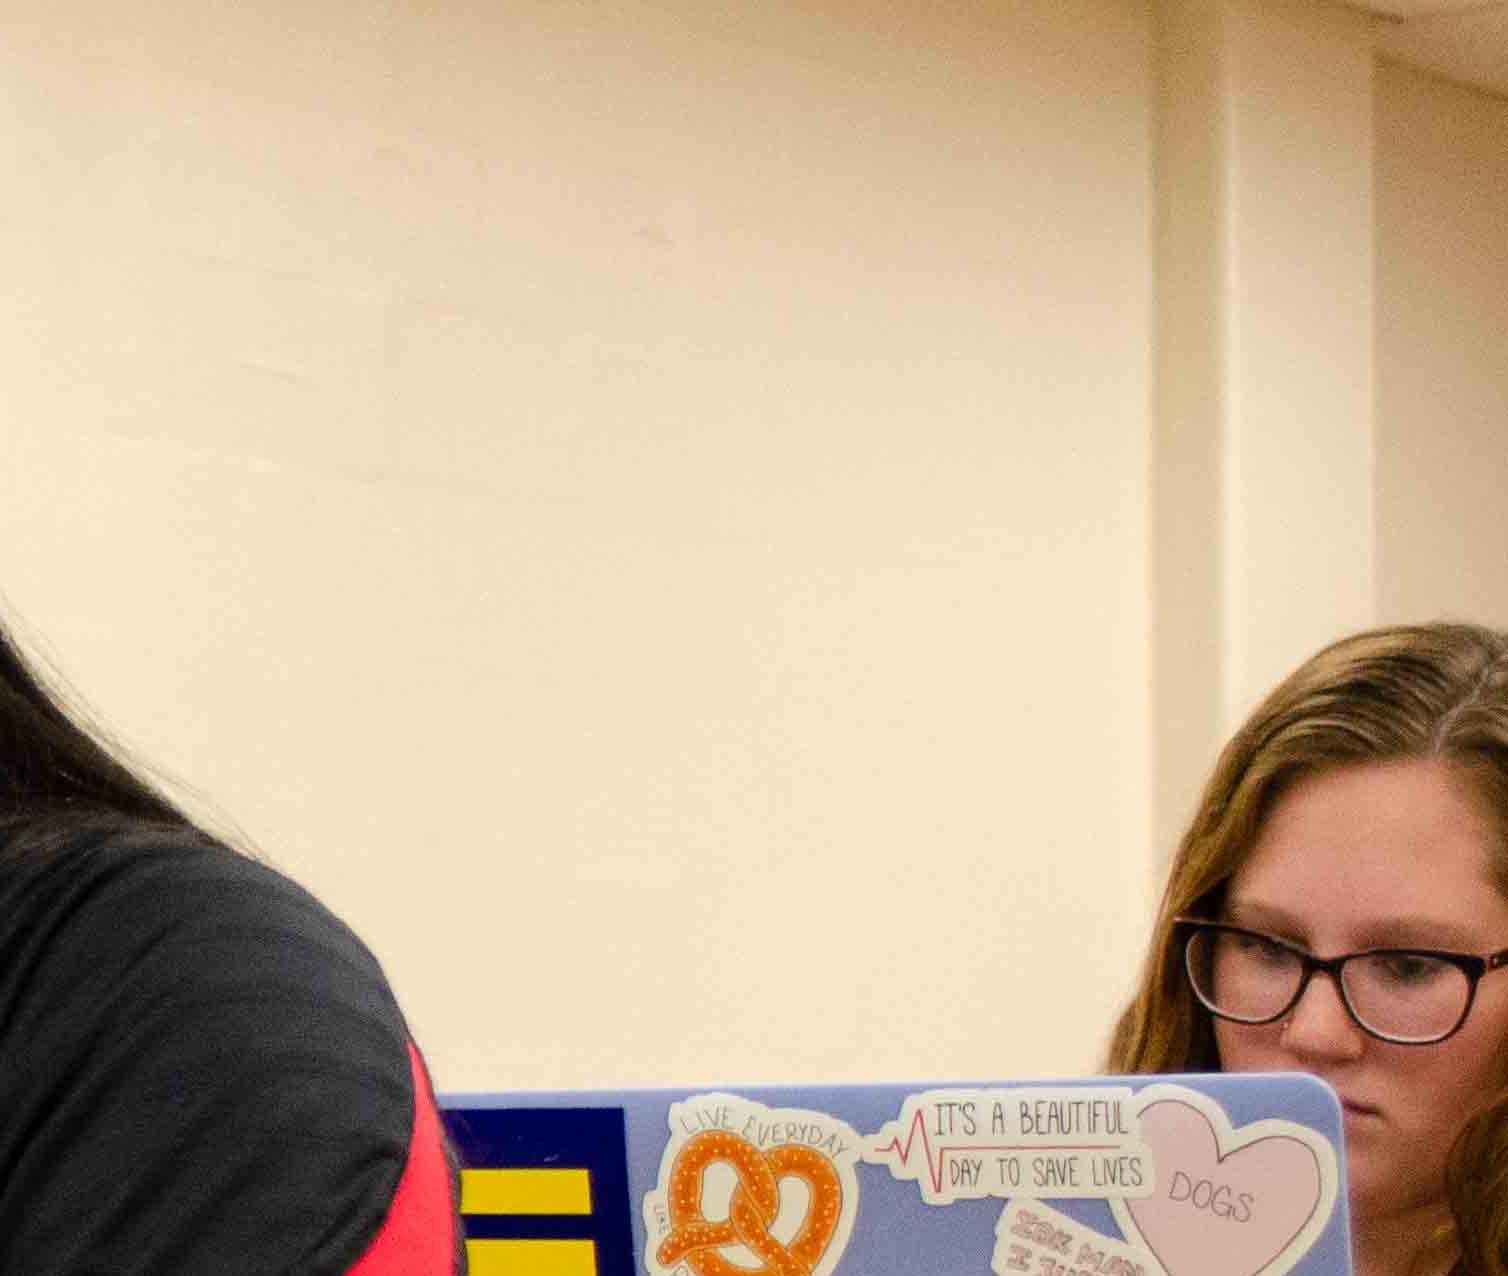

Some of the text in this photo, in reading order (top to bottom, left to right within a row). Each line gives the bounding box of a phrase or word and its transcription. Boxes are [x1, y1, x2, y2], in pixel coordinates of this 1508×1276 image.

[679, 1103, 850, 1159] LIVE EVERYDAY
[934, 1099, 1129, 1136] IT'S A BEAUTIFUL
[950, 1156, 1143, 1187] DAY TO SAVE LIVES
[1168, 1170, 1255, 1223] DOGS
[1007, 1244, 1032, 1272] I
